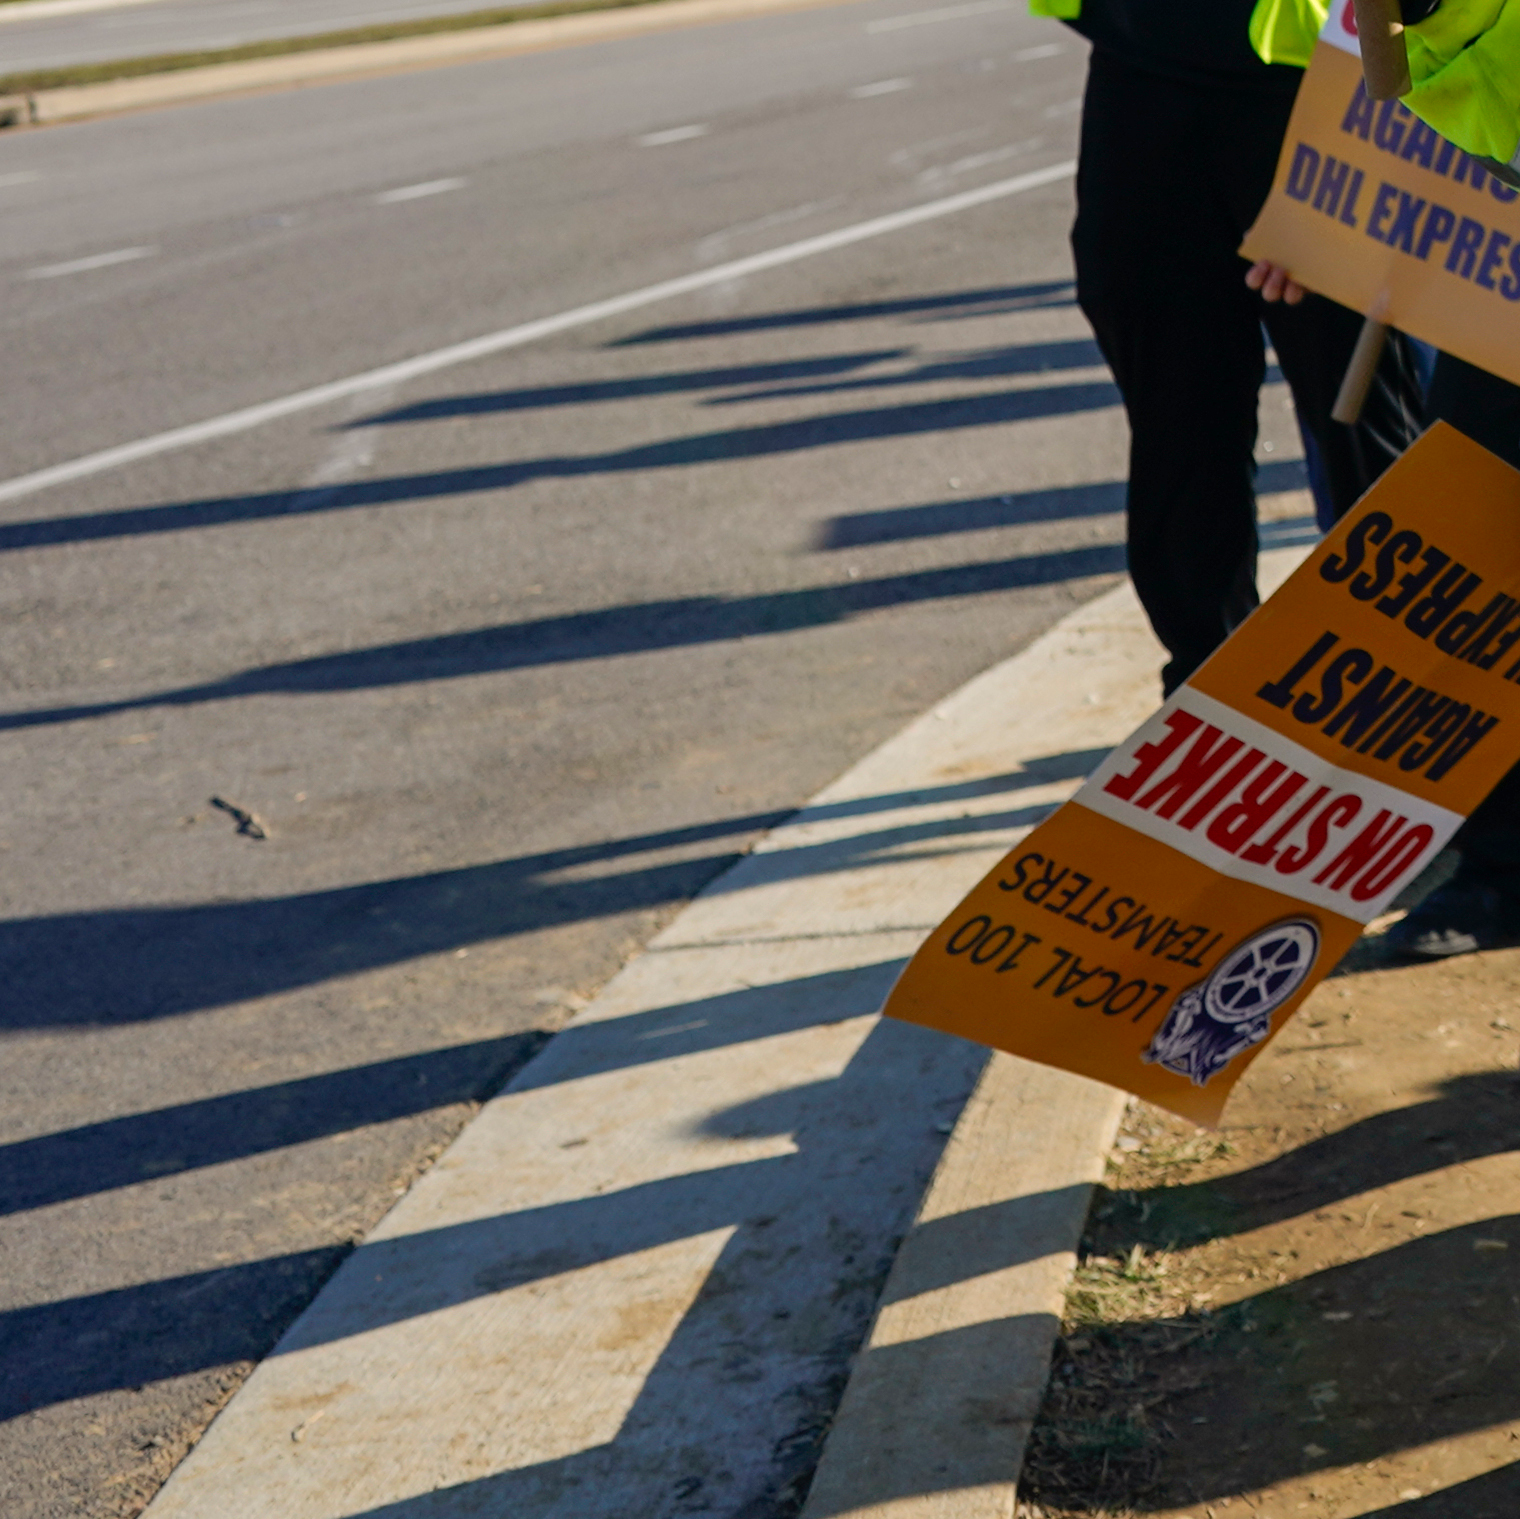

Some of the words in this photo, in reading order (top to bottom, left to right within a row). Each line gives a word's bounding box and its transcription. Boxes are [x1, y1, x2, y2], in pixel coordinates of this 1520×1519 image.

[1285, 143, 1365, 228] DHL
[1255, 630, 1500, 782] AGAINST
[1103, 707, 1363, 875] STRIKE
[1311, 808, 1434, 902] ON
[945, 914, 1042, 973] 100
[997, 852, 1224, 968] TEAMSTERS
[1033, 947, 1170, 1024] LOCAL
